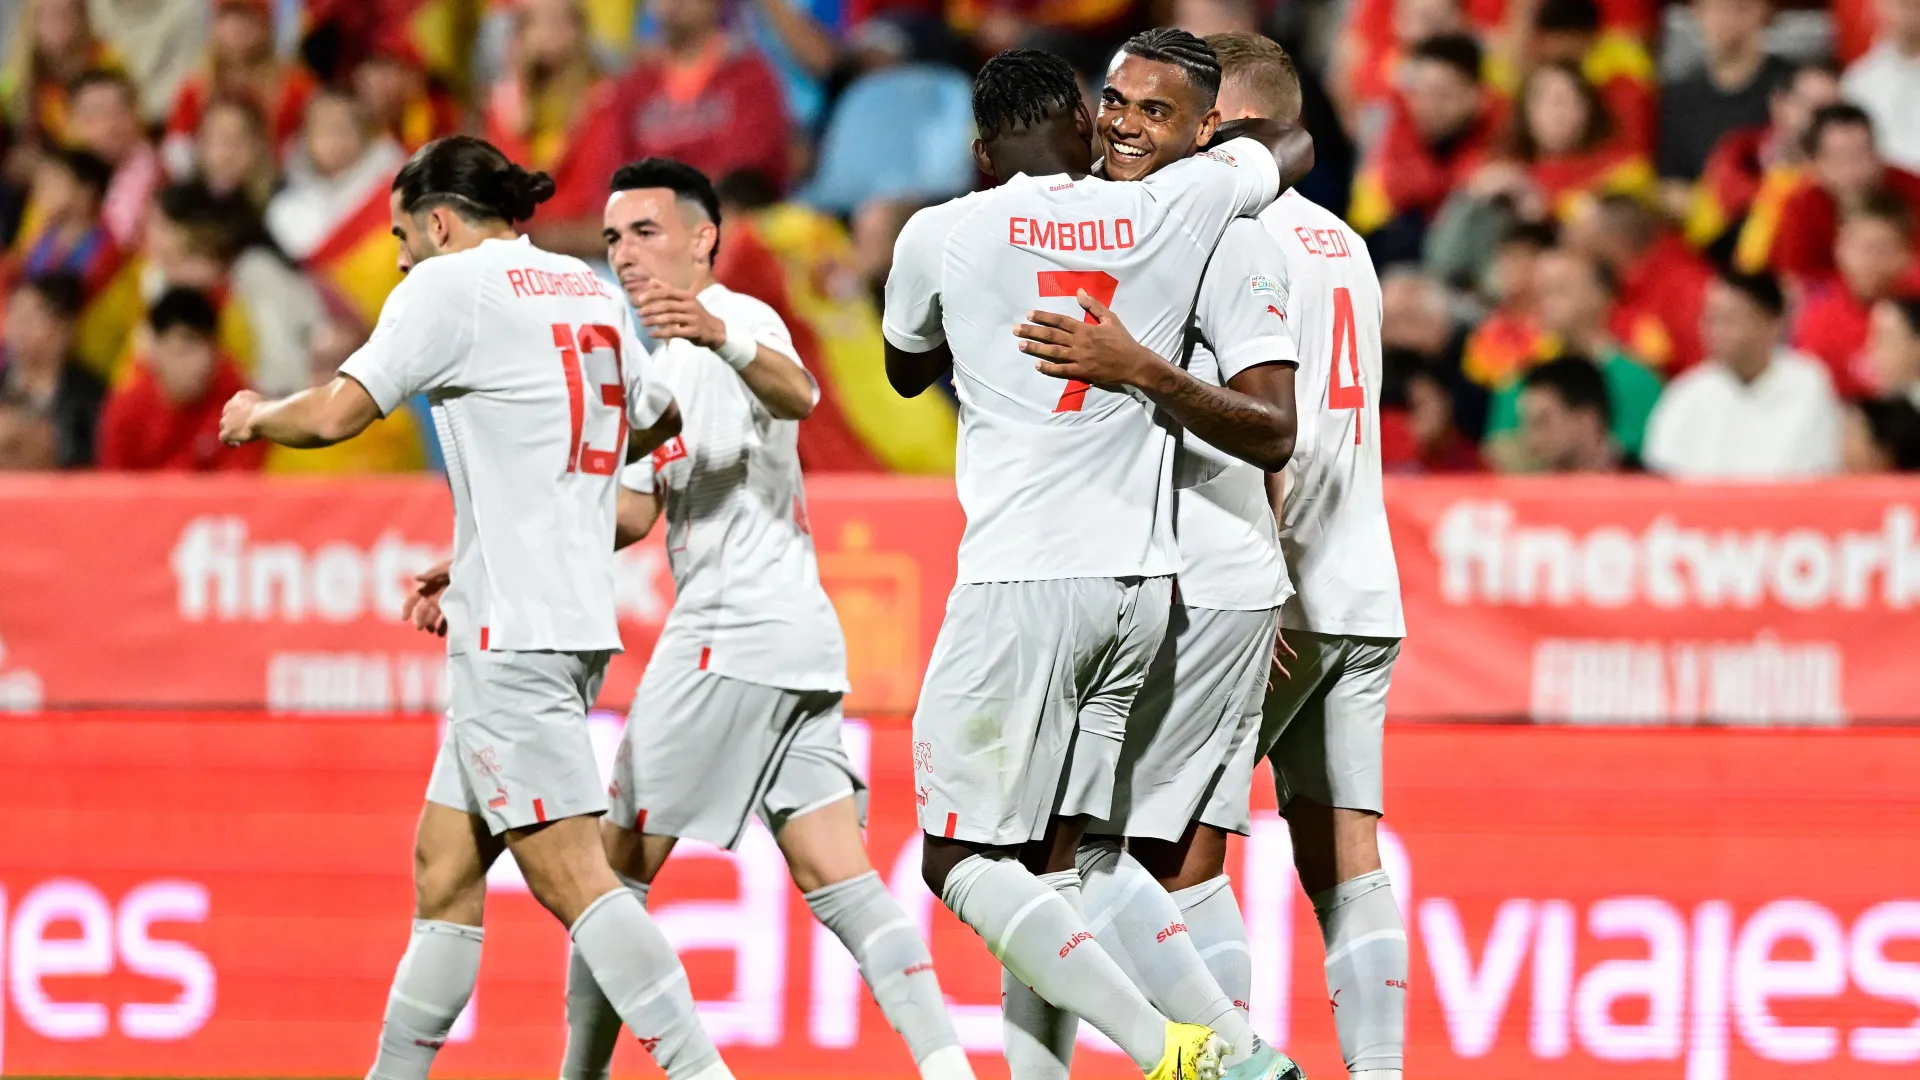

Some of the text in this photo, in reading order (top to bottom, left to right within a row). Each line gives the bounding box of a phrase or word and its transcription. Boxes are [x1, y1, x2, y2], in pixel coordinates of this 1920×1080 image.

[1049, 183, 1075, 191] suisse
[1009, 216, 1135, 251] EMBOLO
[506, 267, 612, 299] RODRIGUE
[1036, 270, 1120, 414] 7
[1328, 287, 1365, 446] 4
[551, 323, 628, 476] 13
[1059, 931, 1094, 958] suiss
[1156, 920, 1188, 943] suiss
